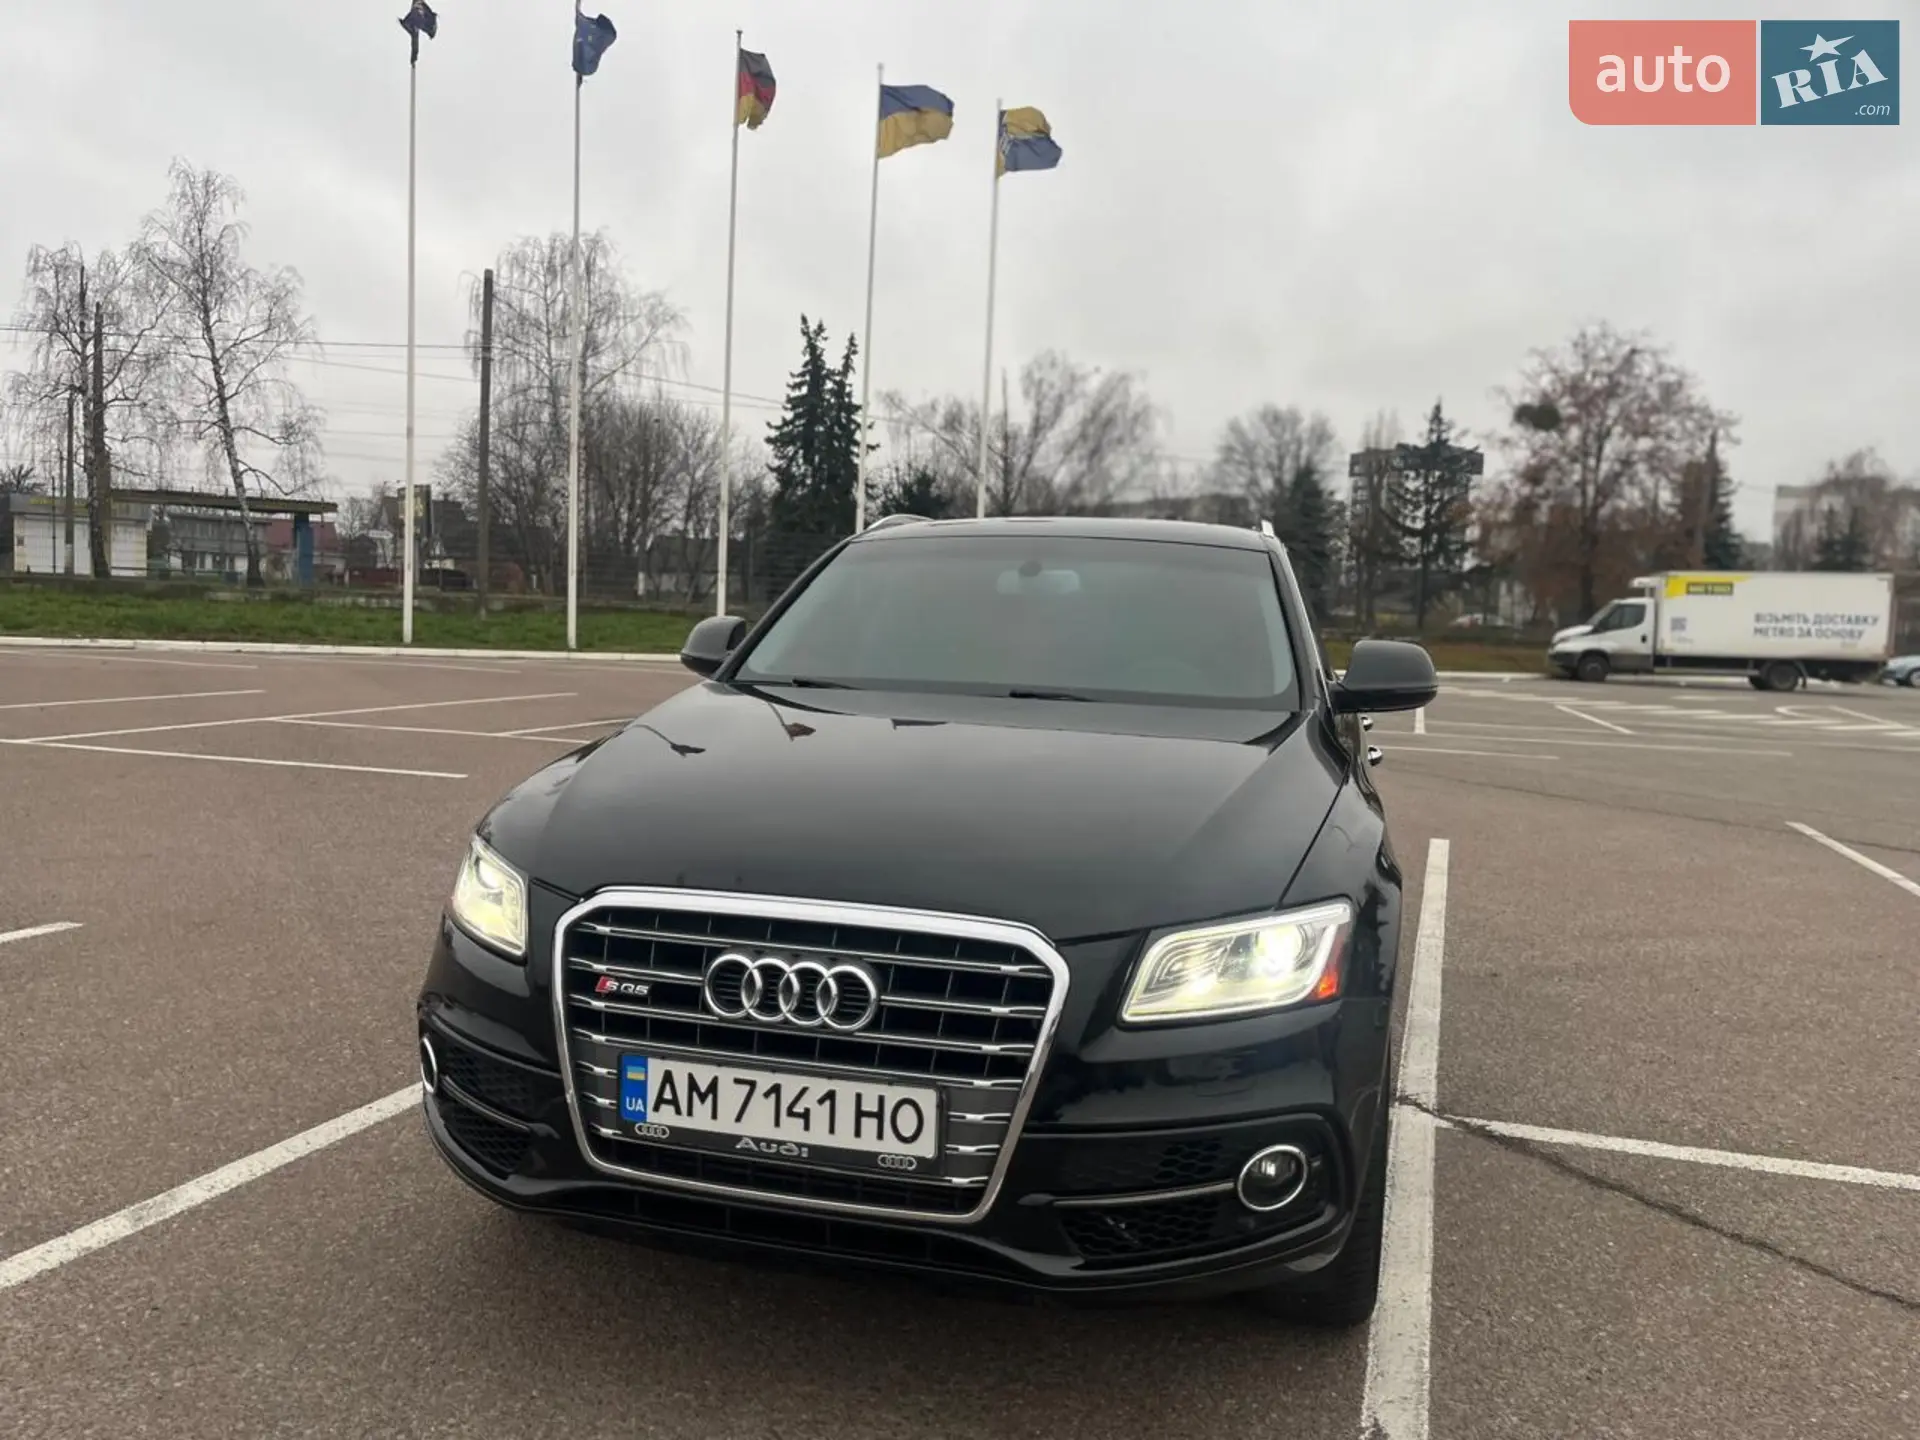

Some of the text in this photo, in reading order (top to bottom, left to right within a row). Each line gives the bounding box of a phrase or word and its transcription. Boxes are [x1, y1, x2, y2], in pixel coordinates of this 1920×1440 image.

[1812, 613, 1879, 627] ДОСТАВКУ
[625, 1096, 645, 1113] UA
[652, 1069, 925, 1144] AM 7141 HO
[735, 1137, 809, 1158] Audi
